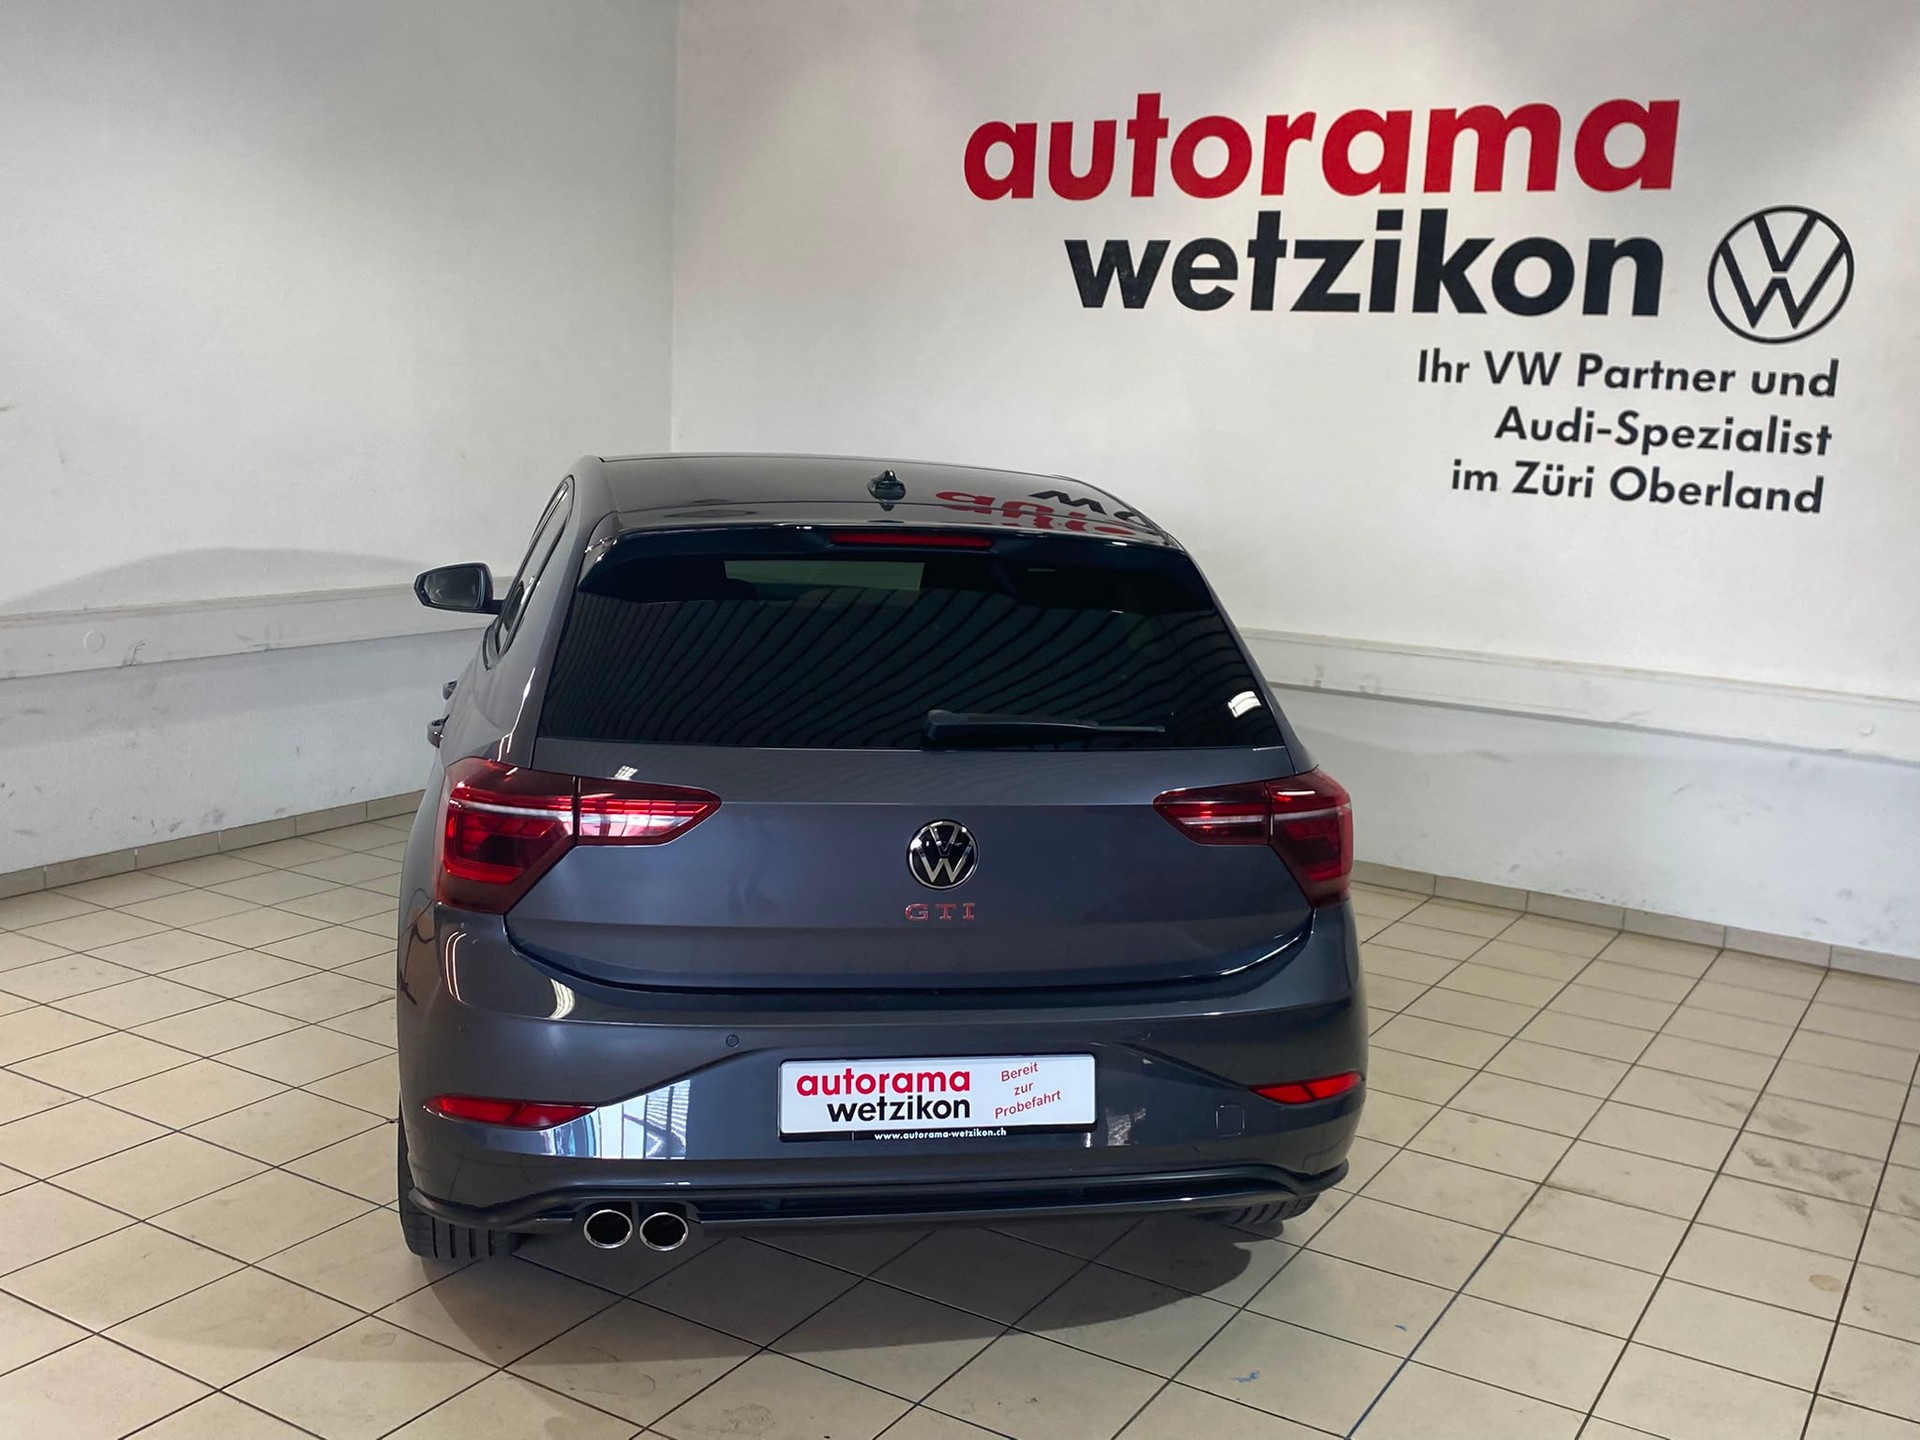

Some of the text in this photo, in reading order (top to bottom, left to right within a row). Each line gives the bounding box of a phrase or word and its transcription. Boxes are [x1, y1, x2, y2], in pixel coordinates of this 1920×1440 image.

[964, 92, 1680, 200] autorama
[1064, 208, 1664, 317] wetzikon
[1418, 348, 1839, 397] Ihr VW Partner und
[1494, 406, 1832, 456] Audi-Spezialist
[1452, 459, 1824, 513] im Züri Oberland
[904, 902, 975, 922] GTI
[796, 1067, 972, 1098] autorama
[1000, 1062, 1039, 1083] Bereit
[1013, 1080, 1035, 1096] zur
[827, 1095, 970, 1122] wetzikon
[994, 1089, 1062, 1119] Probefahrt
[874, 1127, 1007, 1141] www.autorama-wetzikon.ch
